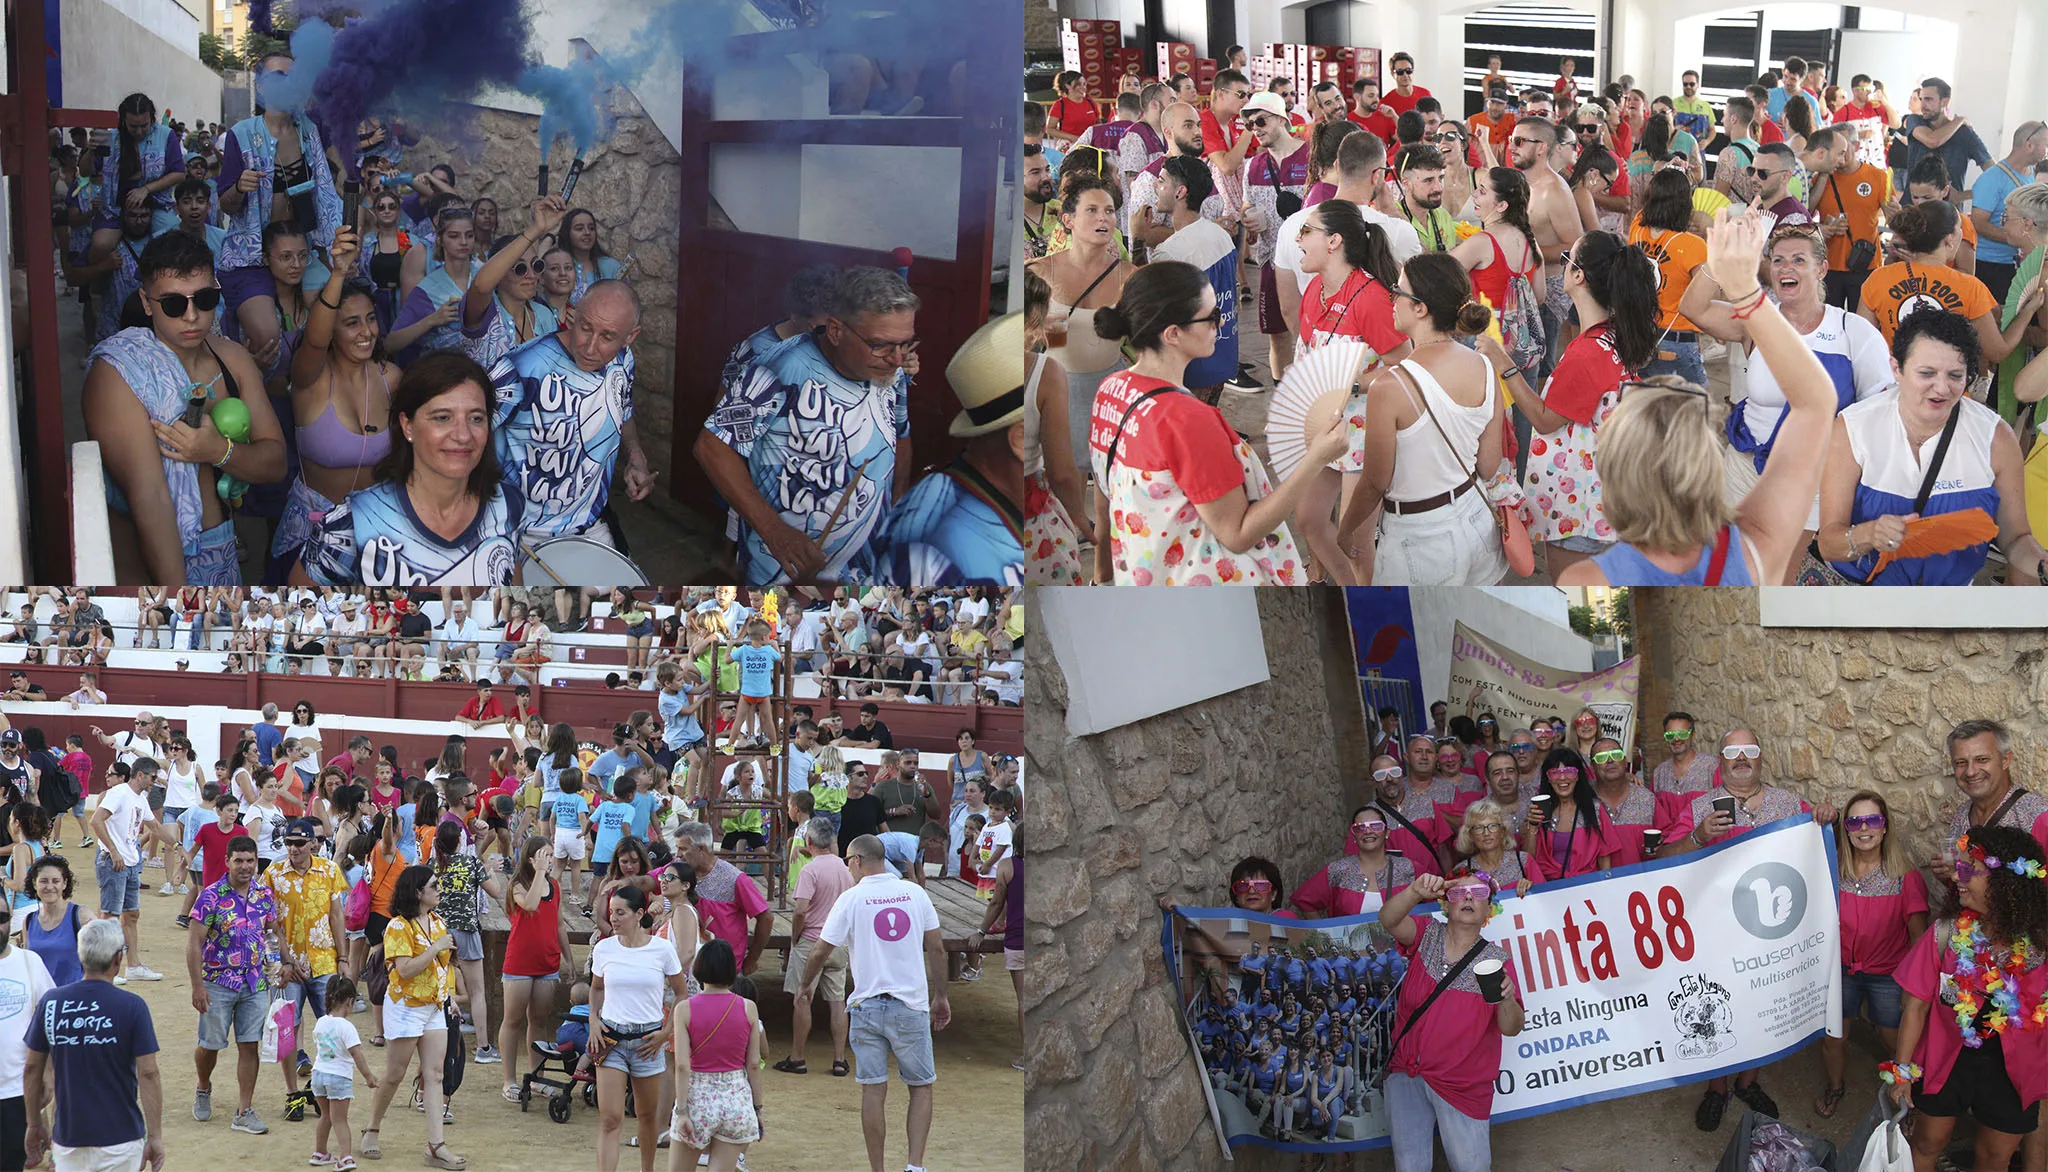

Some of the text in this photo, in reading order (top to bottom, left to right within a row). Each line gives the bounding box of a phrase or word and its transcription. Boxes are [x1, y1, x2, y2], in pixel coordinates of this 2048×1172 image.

[1930, 280, 1963, 309] 2001
[1934, 480, 1964, 490] RENE
[1452, 674, 1557, 710] COM ESTA NINGUNA
[1520, 668, 1546, 687] 88
[1497, 707, 1525, 720] FENT
[1491, 885, 1695, 993] intà 88
[1732, 930, 1825, 974] bauservice
[1750, 955, 1820, 990] Multiservicios
[61, 1000, 100, 1014] ELS
[1523, 991, 1649, 1032] Esta Ninguna
[56, 1017, 113, 1031] MORTS
[55, 1035, 80, 1045] DE
[1518, 1026, 1611, 1059] ONDARA
[1494, 1040, 1665, 1095] 0 aniversari
